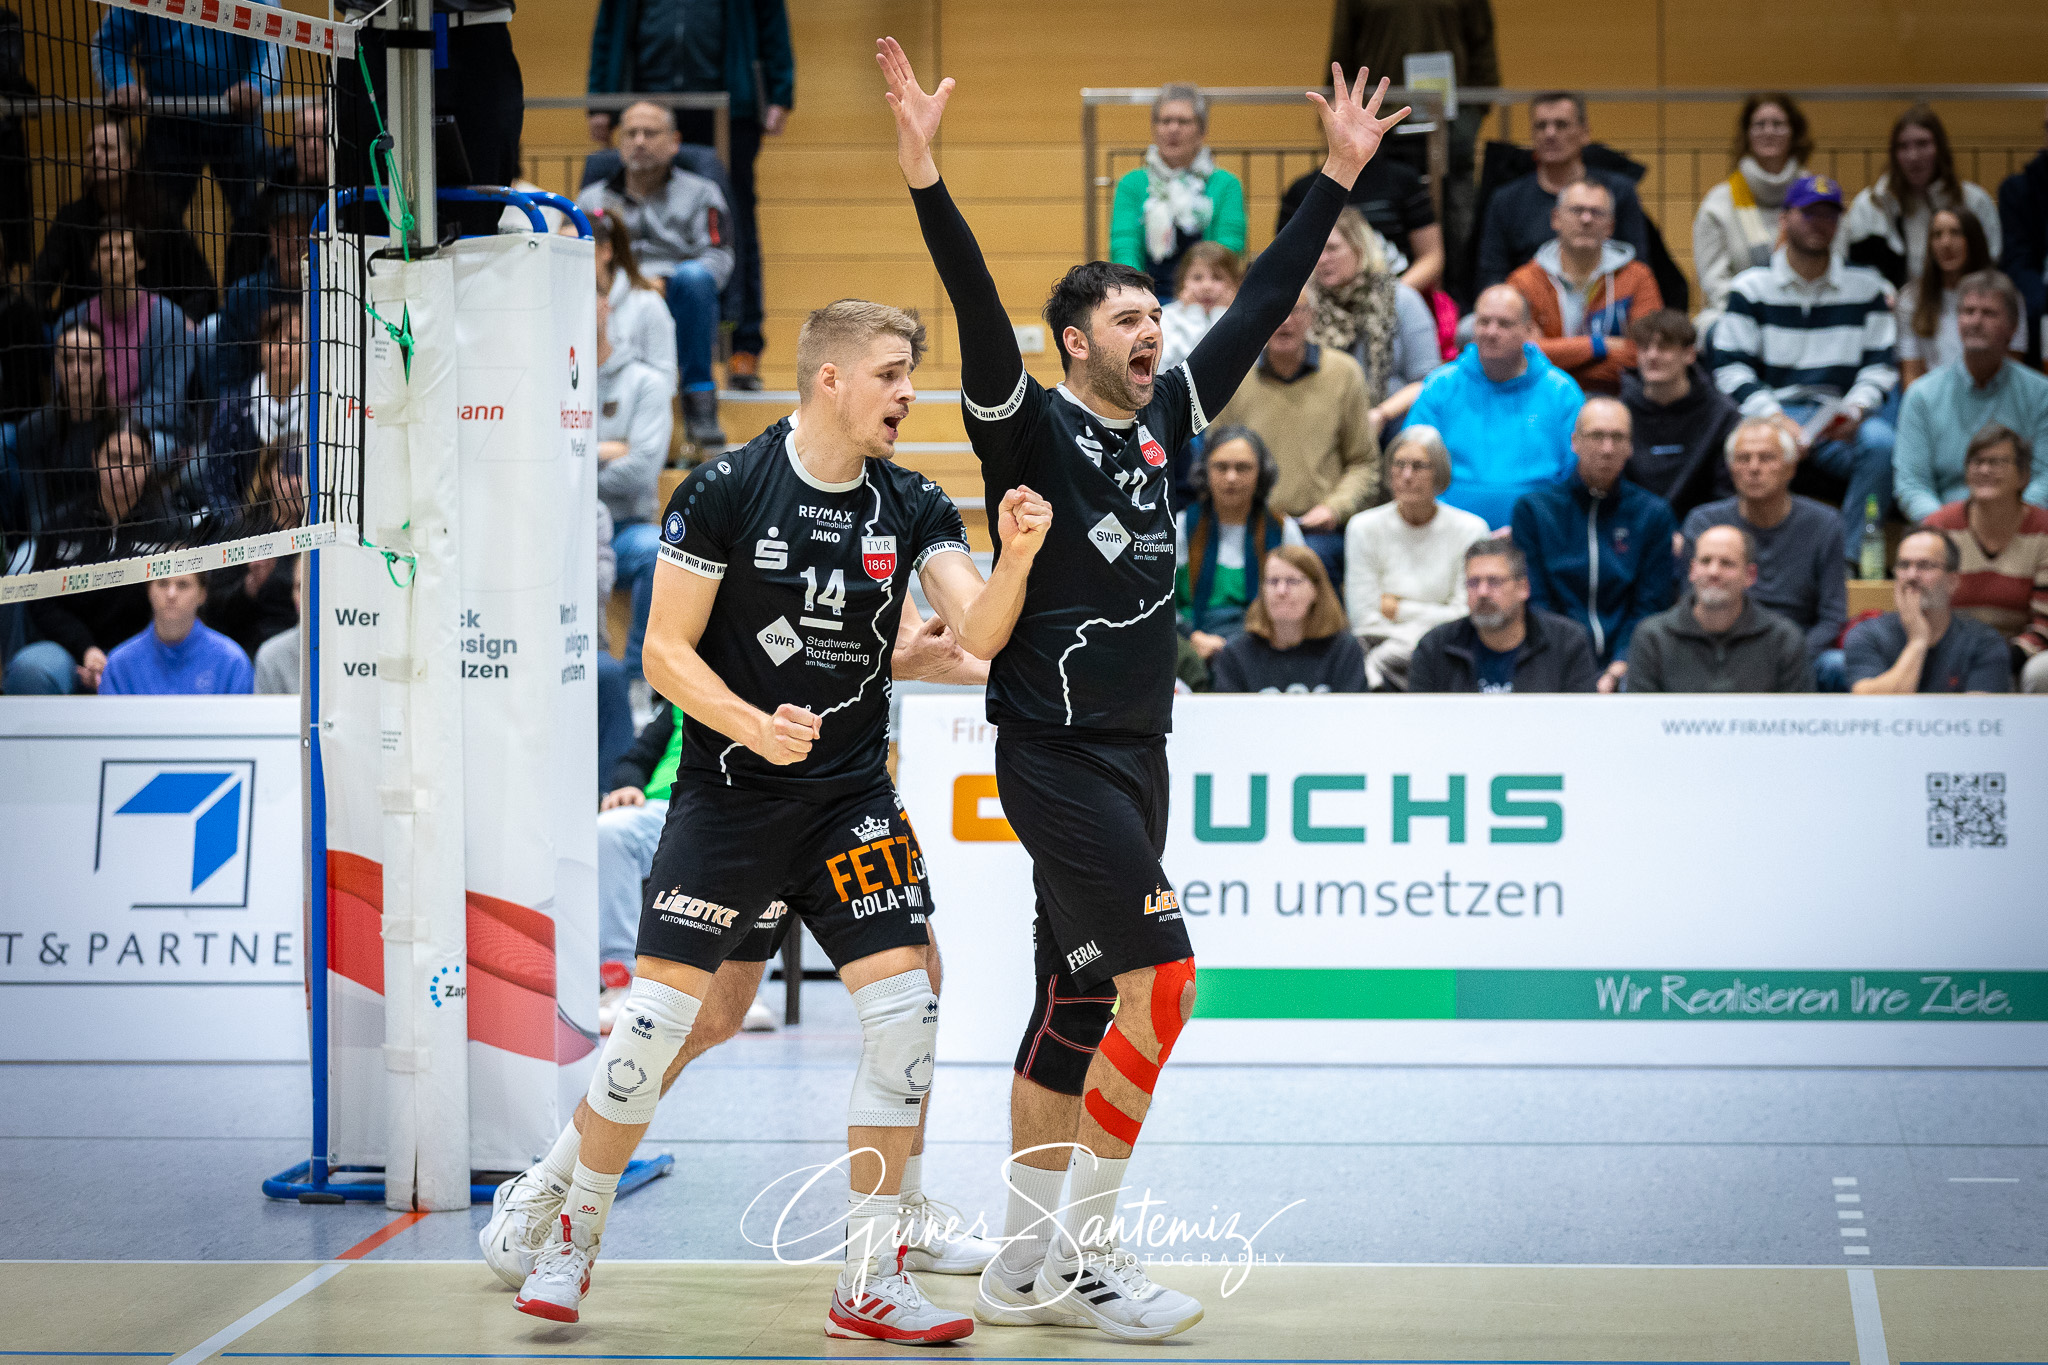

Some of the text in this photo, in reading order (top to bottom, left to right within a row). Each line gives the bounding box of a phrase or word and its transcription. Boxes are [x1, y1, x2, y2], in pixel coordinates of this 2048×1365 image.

[798, 504, 853, 523] RE/MAX
[816, 519, 853, 530] Immobilien
[810, 529, 841, 543] JAKO
[1096, 530, 1122, 544] SWR
[867, 540, 891, 551] TVR
[929, 543, 946, 552] WIR
[151, 559, 171, 577] FUCHS
[670, 549, 684, 562] WIR
[685, 555, 700, 568] WIR
[700, 561, 716, 574] WIR
[867, 559, 892, 571] 1861
[67, 573, 89, 591] FUCHS
[800, 566, 847, 616] 14
[764, 633, 796, 649] SWR
[806, 635, 861, 651] Stadtwerke
[805, 646, 870, 666] Rottenburg
[816, 661, 837, 670] Neckar
[1192, 772, 1567, 845] UCHS
[1274, 869, 1565, 918] umsetzen
[660, 913, 722, 936] AUTOWASCHCENTER
[39, 932, 71, 966] &
[88, 932, 293, 966] PARTNE
[1066, 940, 1102, 971] FERAL
[1595, 974, 2014, 1016] Wir Realisieren Ihre Ziele.
[550, 1182, 566, 1196] NIKE
